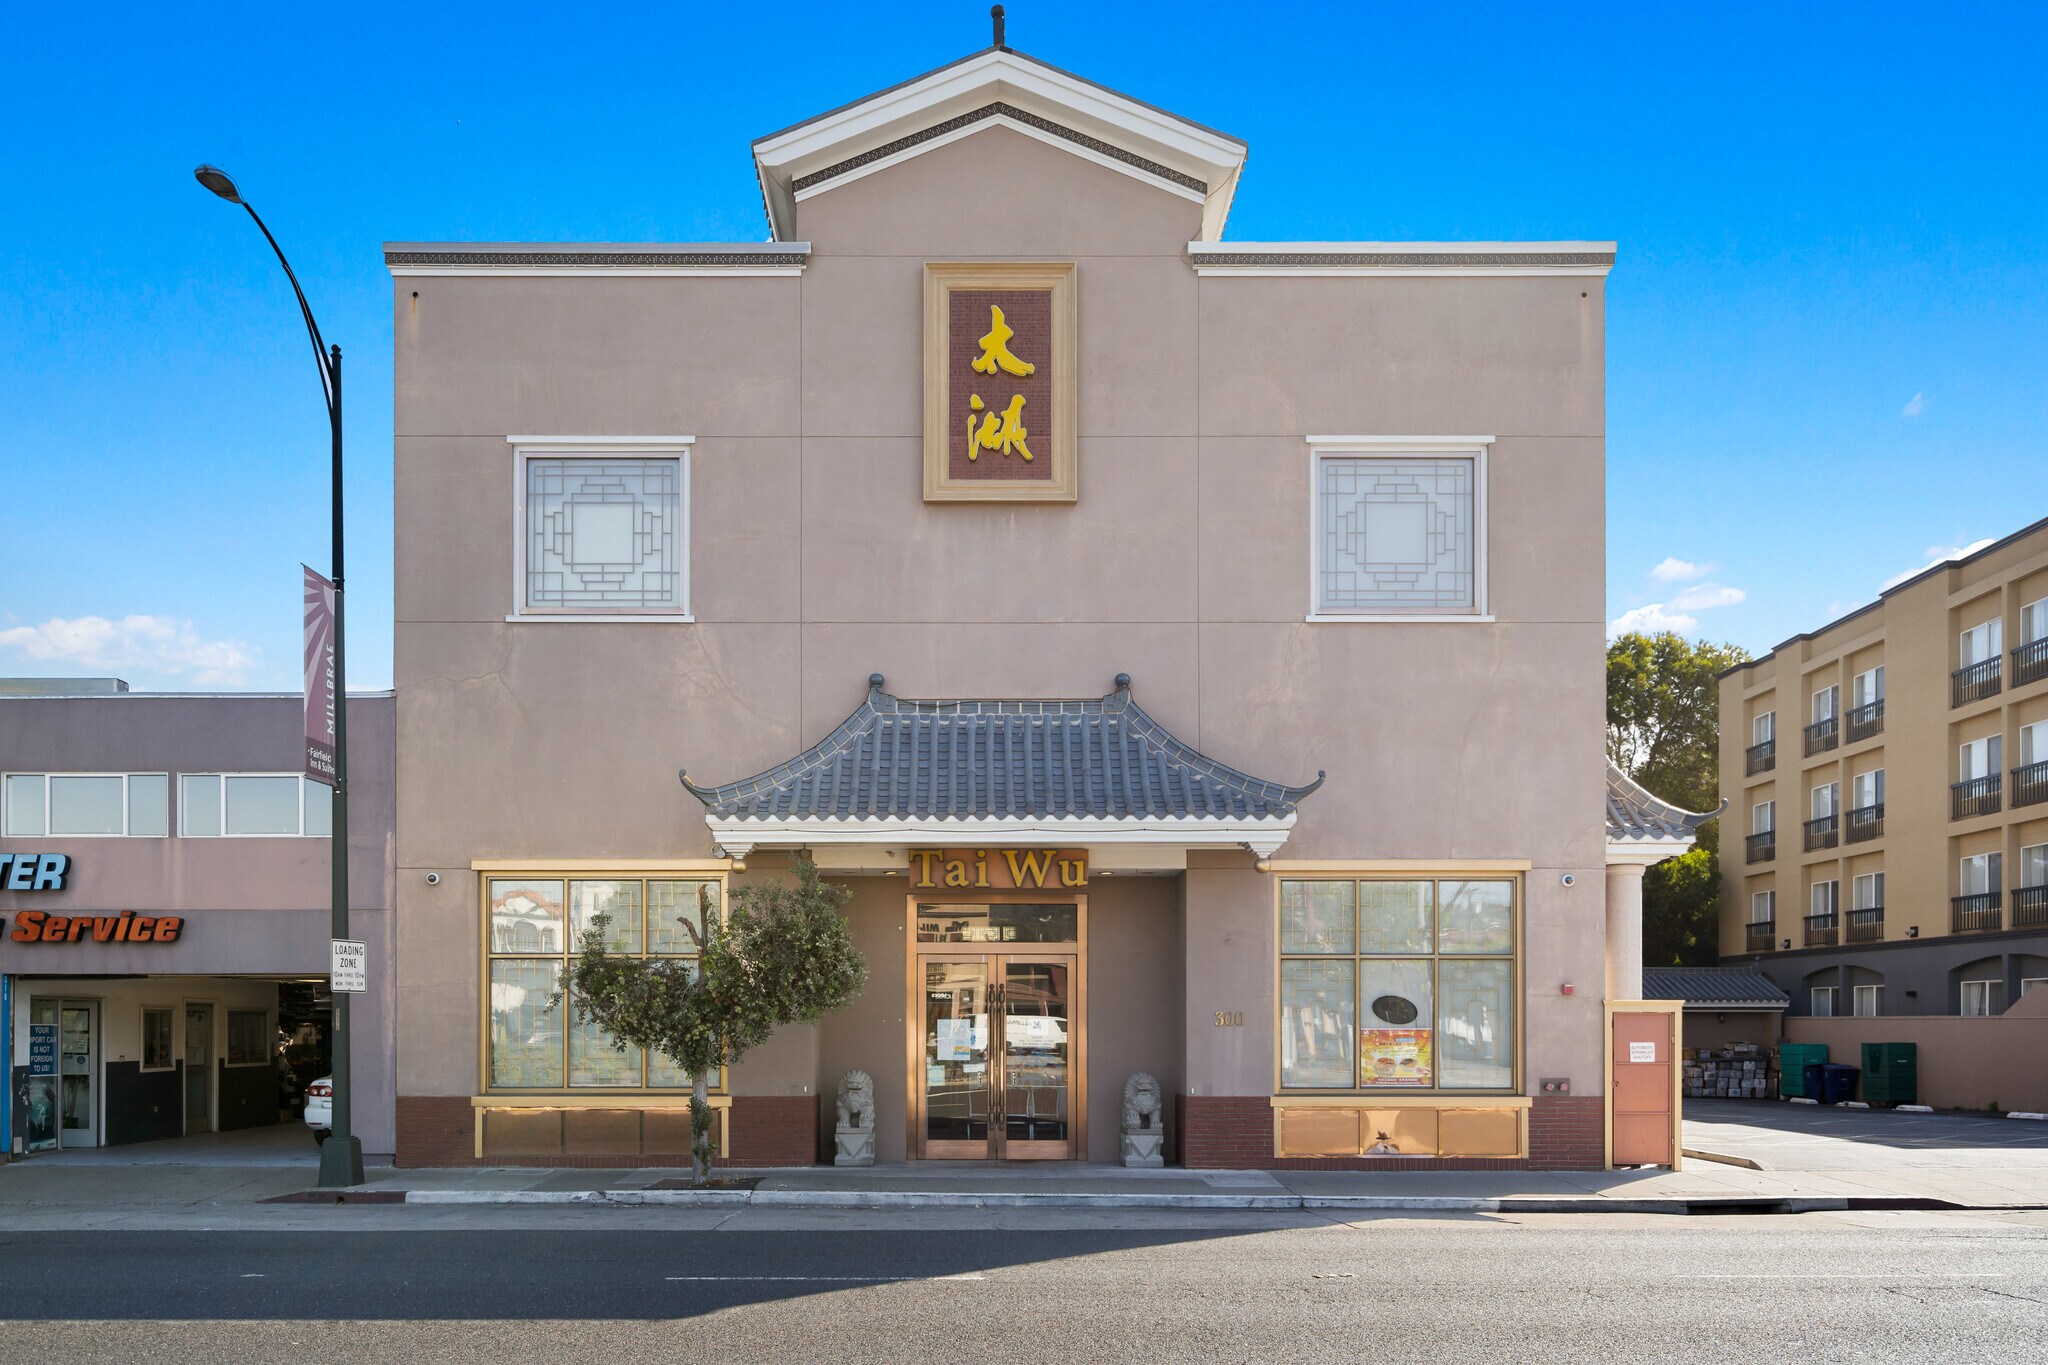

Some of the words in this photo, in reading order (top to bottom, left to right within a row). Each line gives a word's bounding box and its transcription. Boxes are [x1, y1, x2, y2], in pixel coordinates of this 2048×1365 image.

[966, 304, 1036, 461] 太湖
[326, 643, 334, 735] MILLBRAE
[310, 747, 331, 763] Fairfield
[909, 849, 990, 888] Tai
[1002, 850, 1088, 888] Wu
[11, 910, 181, 942] Service
[335, 945, 363, 956] LOADING
[340, 958, 357, 968] ZONE
[1214, 1011, 1243, 1026] 300
[35, 1026, 50, 1034] YOUR
[46, 1036, 57, 1044] CAR
[40, 1045, 51, 1053] NOT
[31, 1055, 53, 1063] FOREIGN
[33, 1064, 40, 1072] TO
